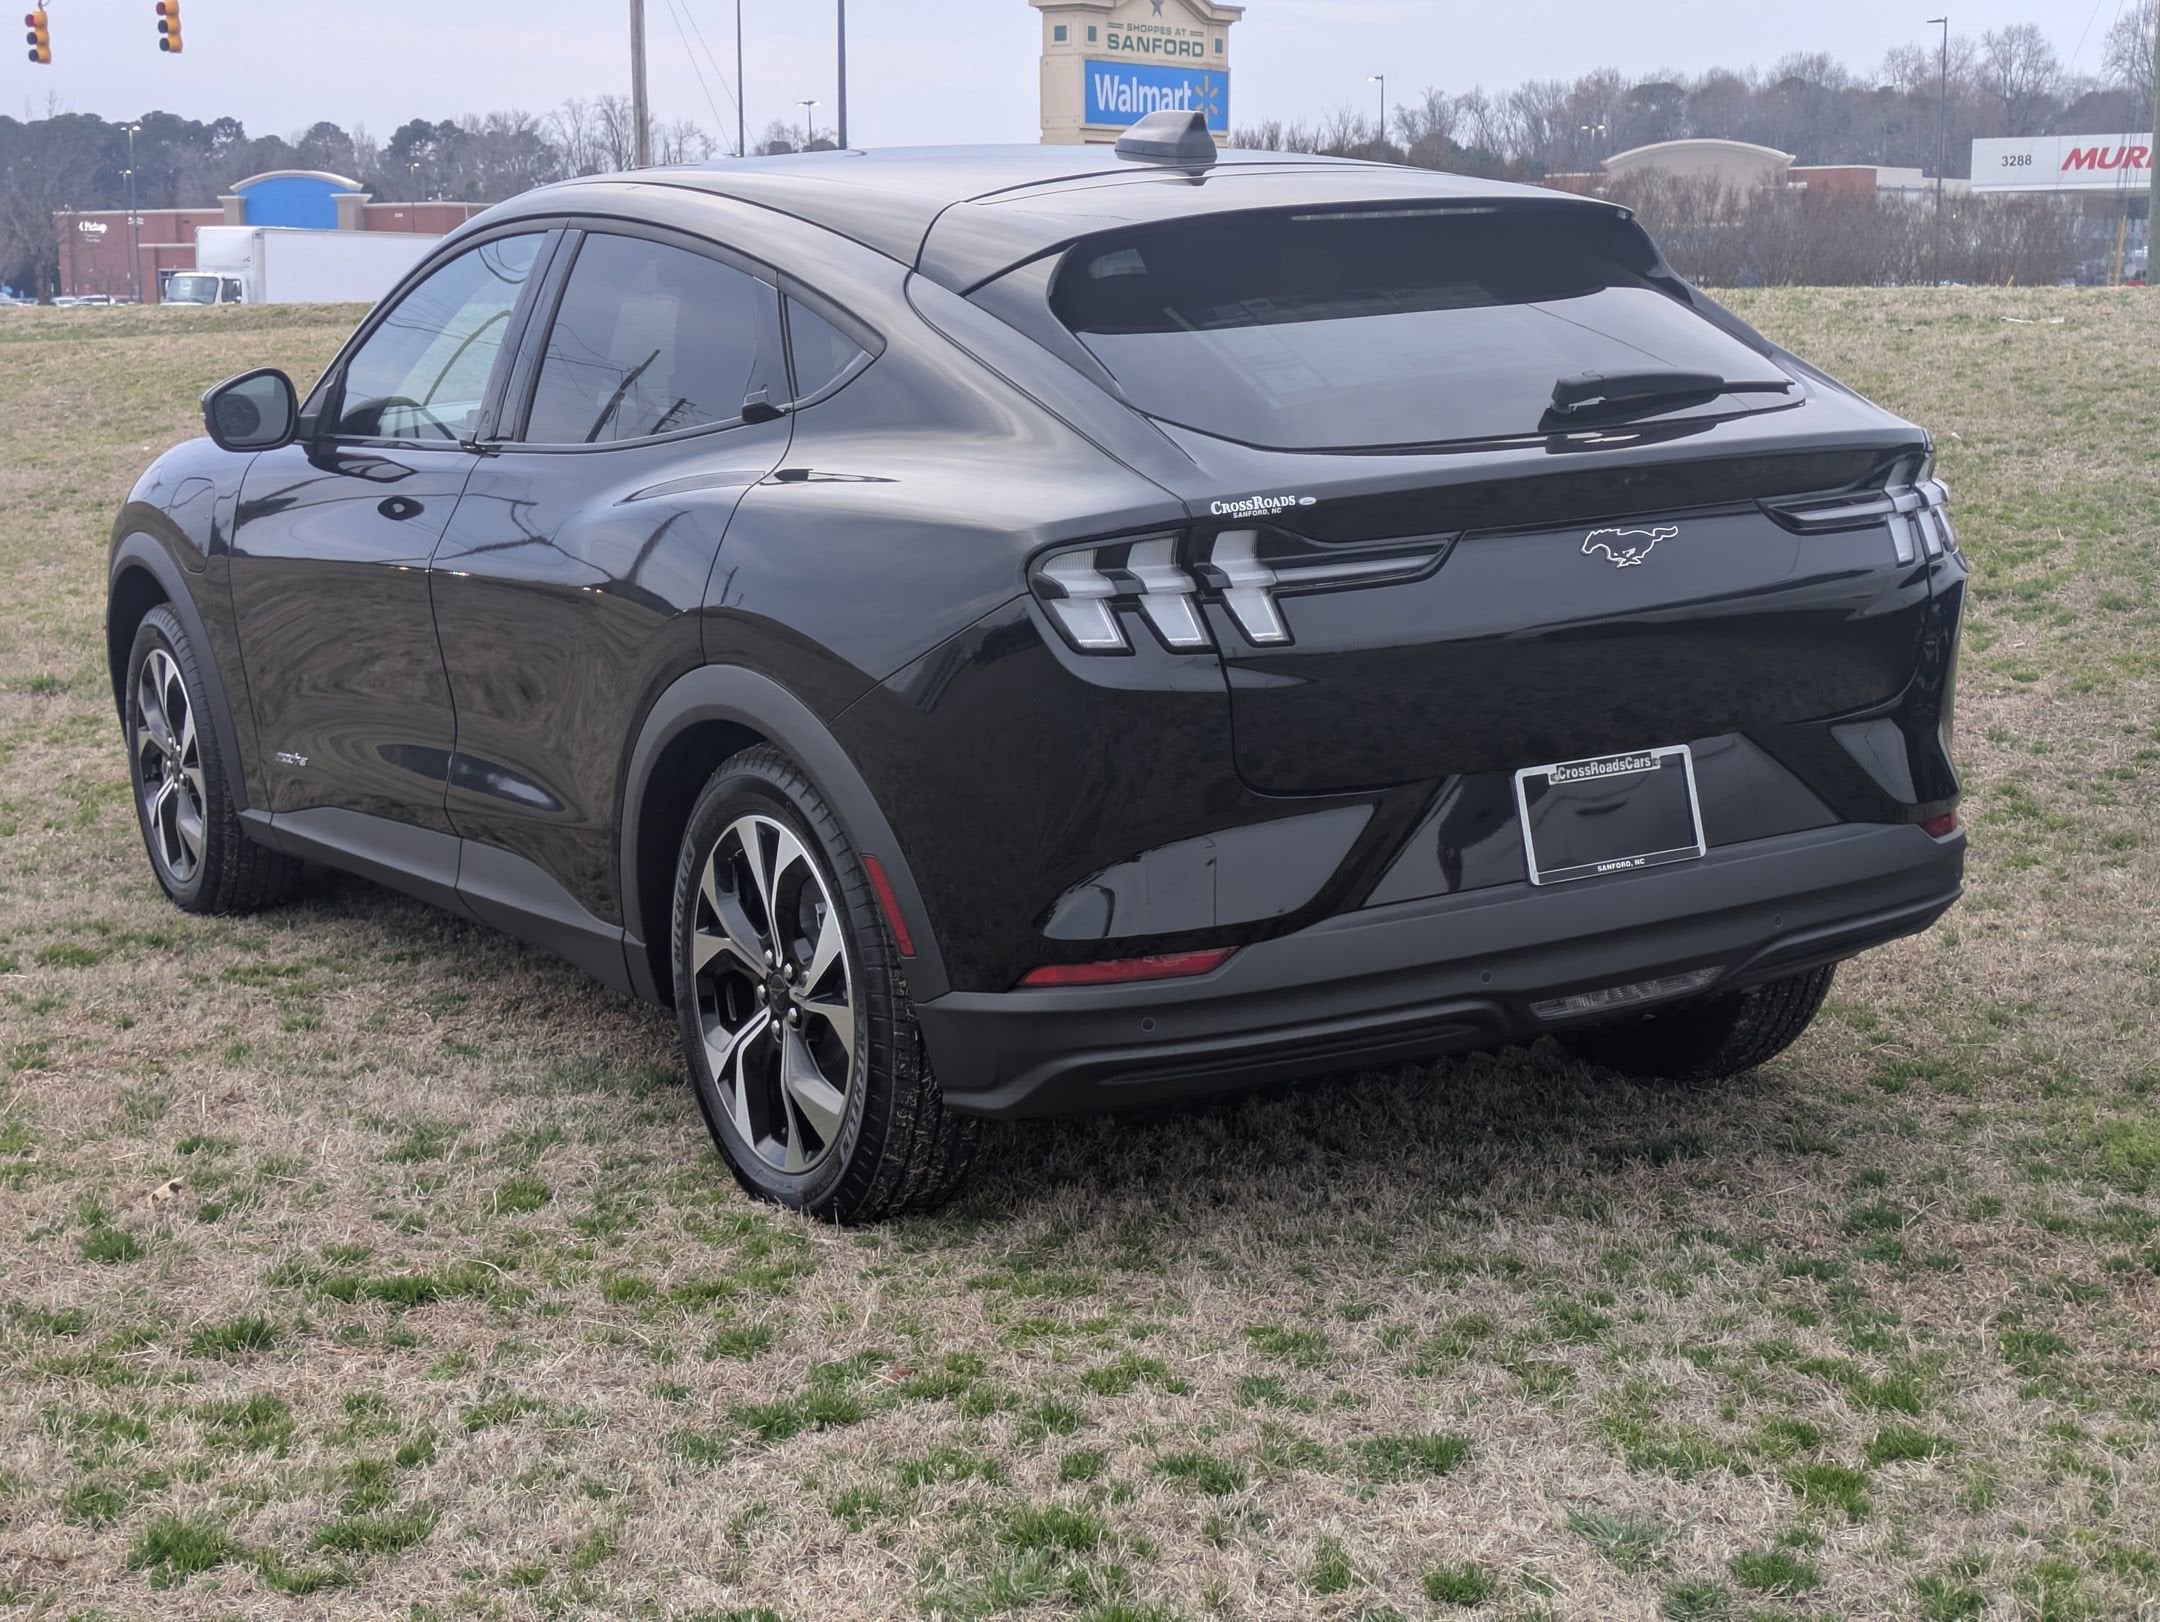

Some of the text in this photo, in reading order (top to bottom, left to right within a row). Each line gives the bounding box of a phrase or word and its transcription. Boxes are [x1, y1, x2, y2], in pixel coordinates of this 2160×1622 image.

[1126, 23, 1187, 37] SHOPPES AT
[1107, 33, 1205, 58] SANFORD
[1094, 73, 1192, 113] Walmart
[2001, 154, 2033, 168] 3288
[1232, 507, 1282, 519] SANFORD, NC
[1558, 757, 1651, 779] CrossRoadsCars
[1597, 858, 1645, 872] SANFORD, NC
